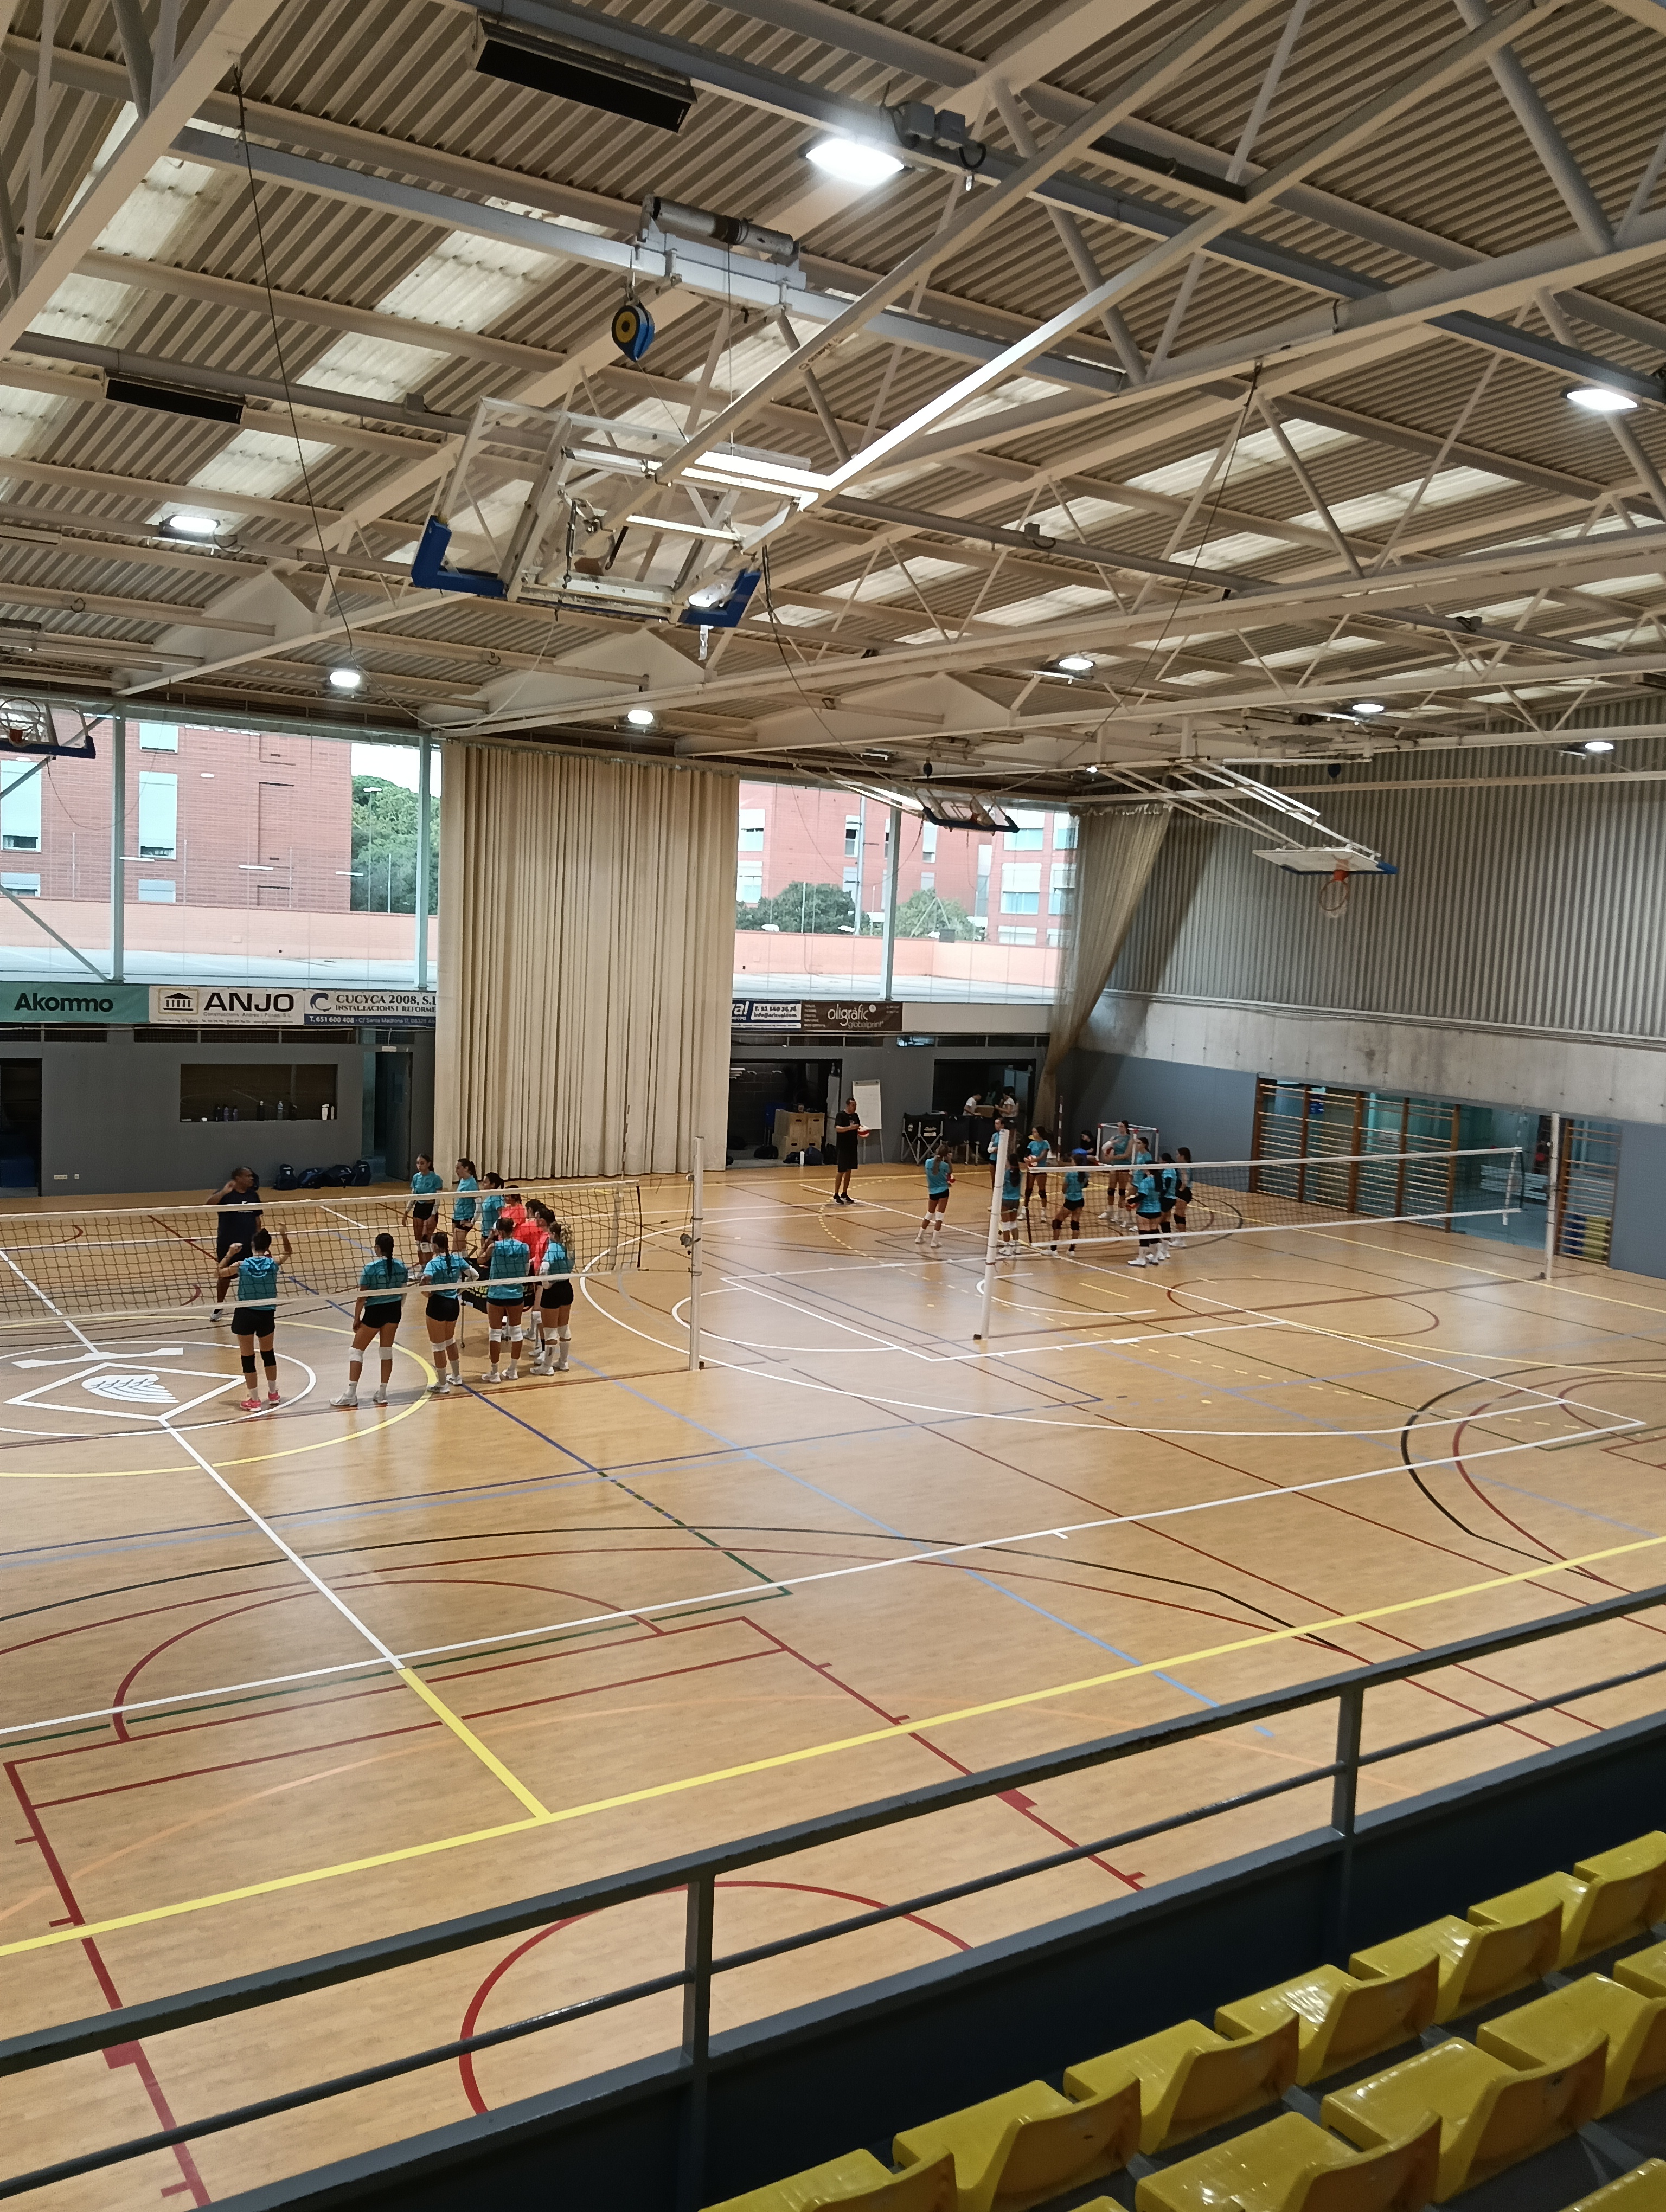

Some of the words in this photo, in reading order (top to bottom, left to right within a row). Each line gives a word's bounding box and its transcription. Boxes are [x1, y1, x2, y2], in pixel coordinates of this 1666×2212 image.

[14, 993, 113, 1012] Akommo
[203, 992, 294, 1012] ANJO
[336, 994, 386, 1004] CUCYCA
[388, 995, 420, 1006] 2008,
